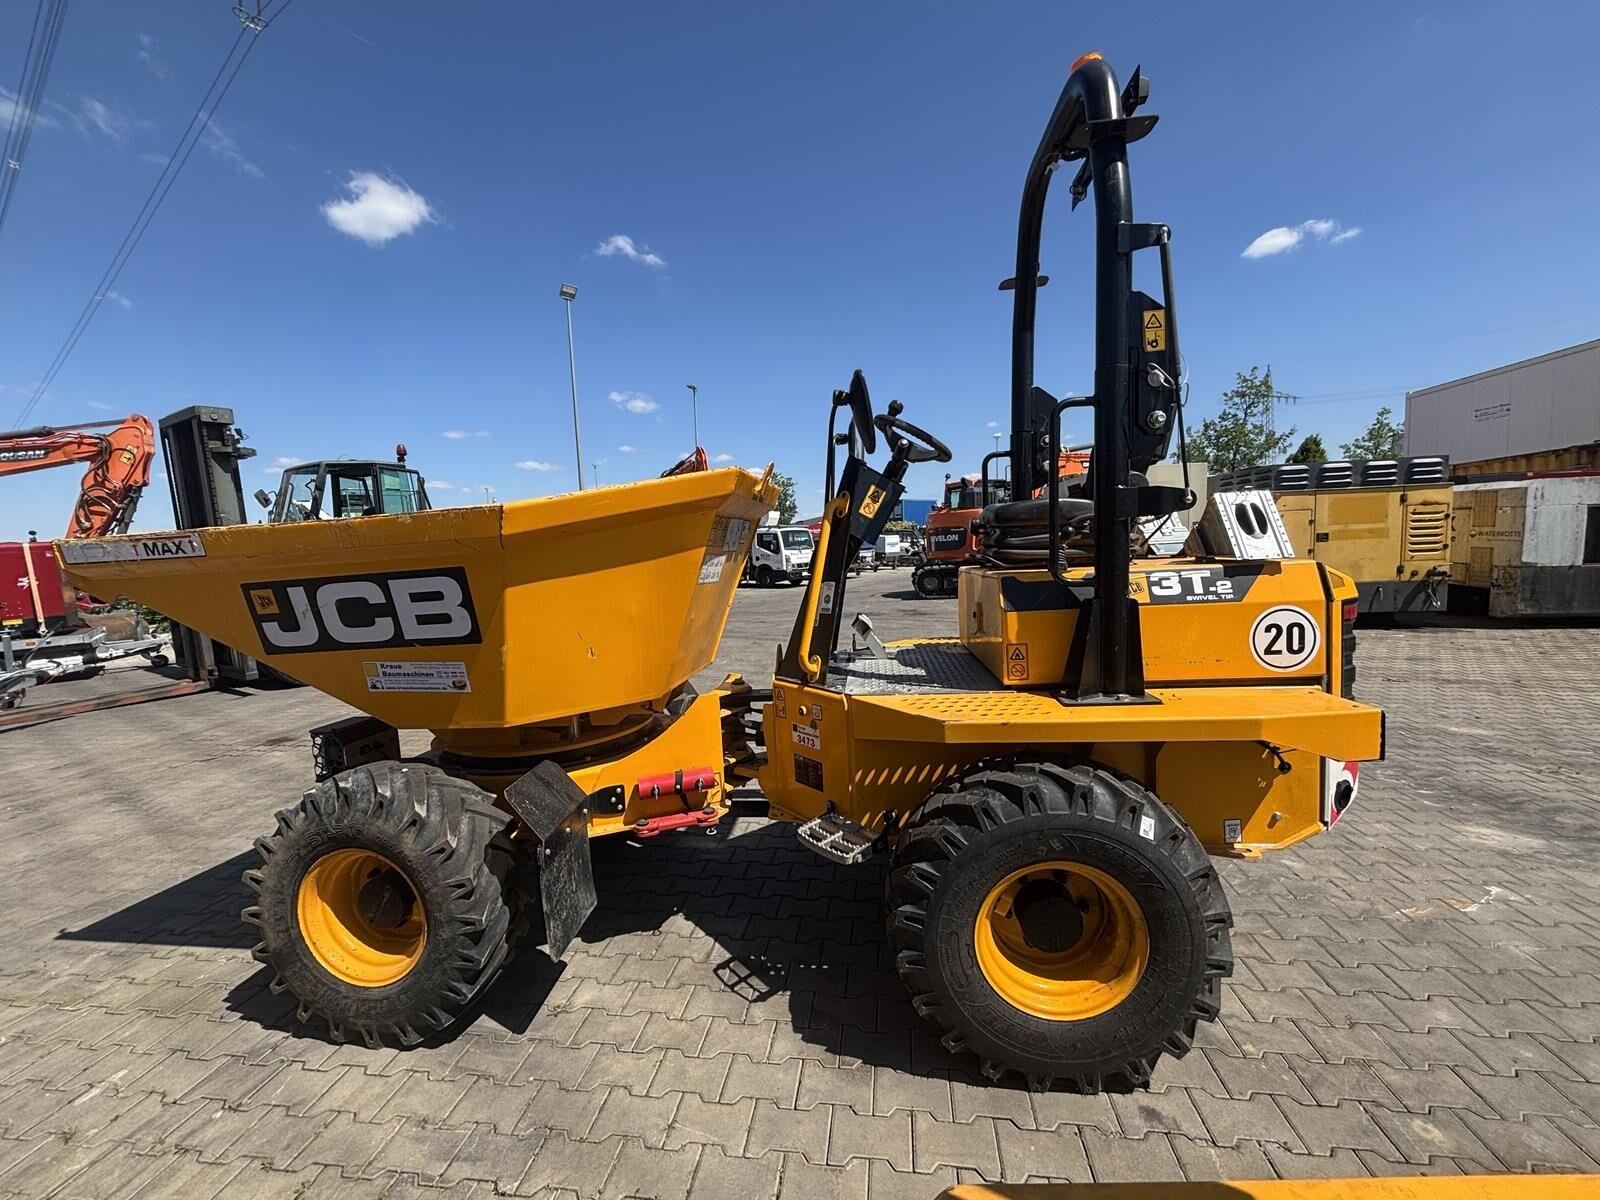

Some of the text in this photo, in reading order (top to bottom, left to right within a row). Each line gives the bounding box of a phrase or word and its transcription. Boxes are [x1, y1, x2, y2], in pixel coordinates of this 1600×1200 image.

[142, 539, 188, 557] MAX
[1186, 594, 1219, 602] SWIVEL
[261, 576, 472, 647] JCB
[1263, 621, 1306, 656] 20
[382, 670, 435, 678] Baumaschinen
[796, 734, 816, 748] 3473
